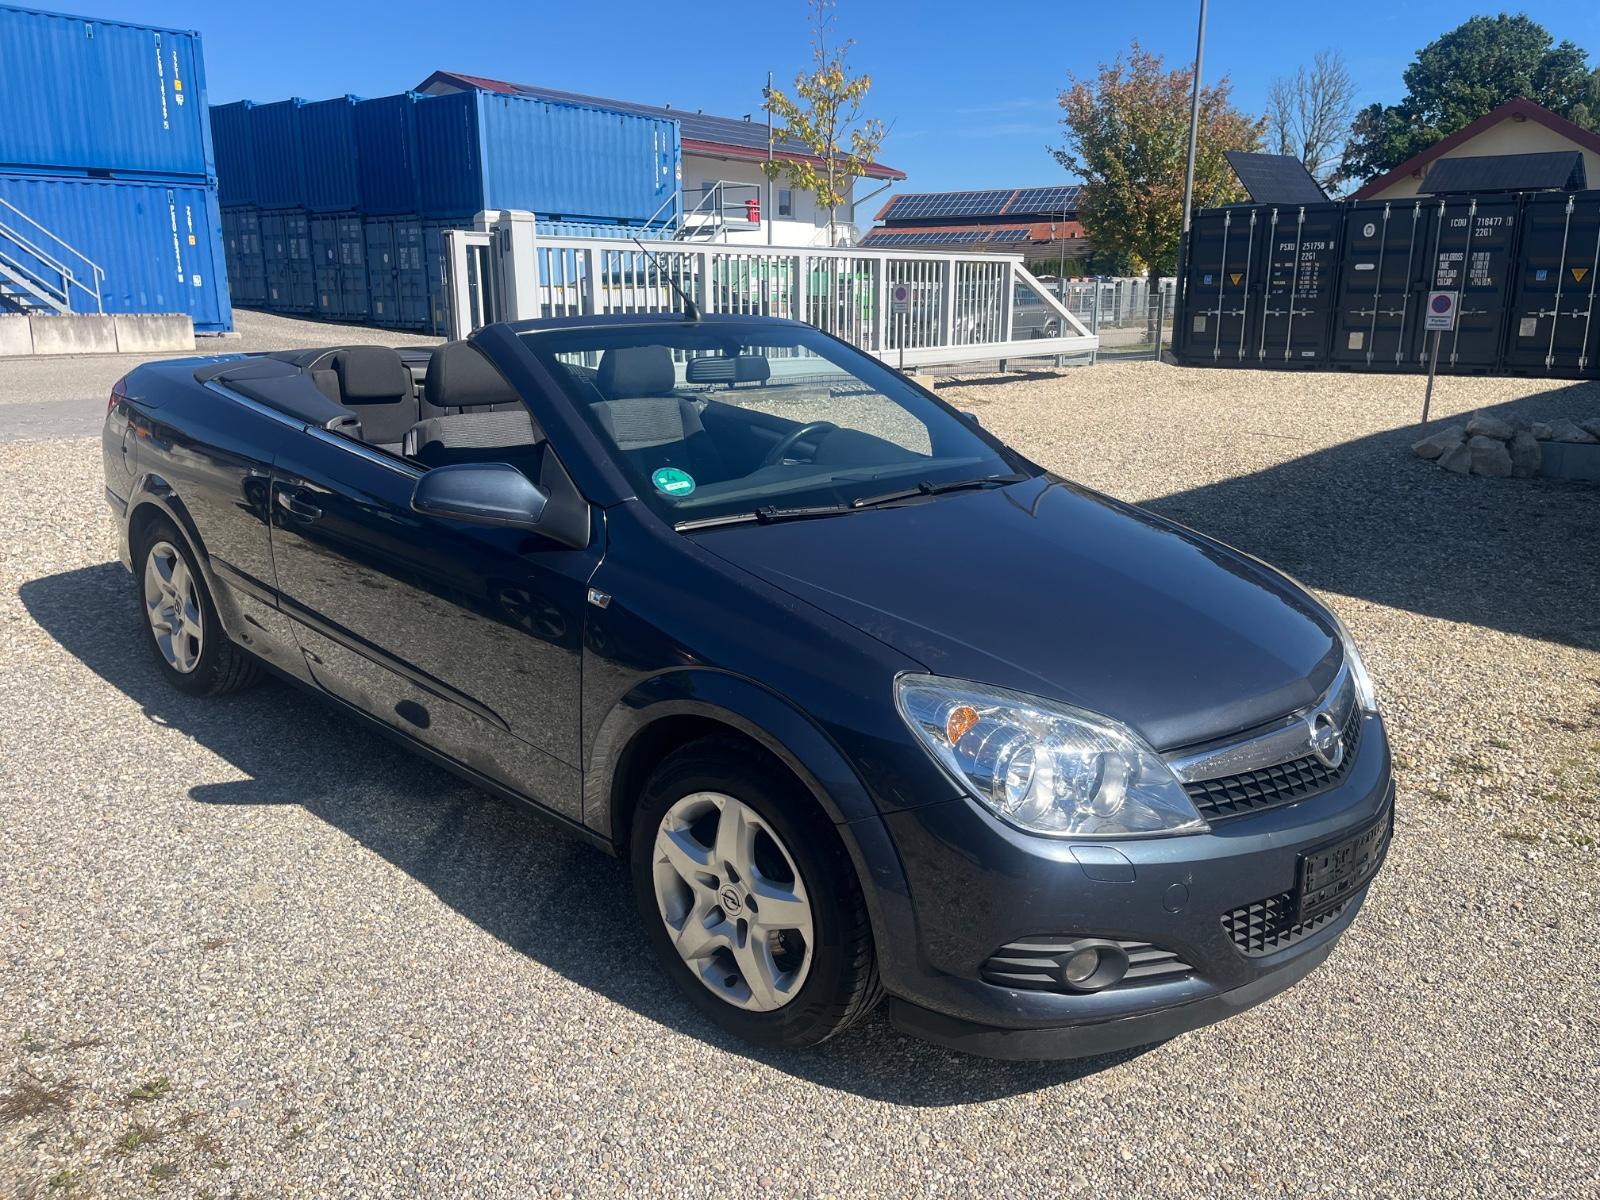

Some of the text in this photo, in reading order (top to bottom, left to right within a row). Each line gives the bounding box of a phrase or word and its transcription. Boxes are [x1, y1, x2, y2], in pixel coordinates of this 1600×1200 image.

[1450, 218, 1467, 227] ICOU
[1477, 217, 1503, 227] 716477
[1475, 228, 1492, 237] 22G1
[1302, 241, 1325, 250] 251758
[1301, 252, 1316, 260] 22G1
